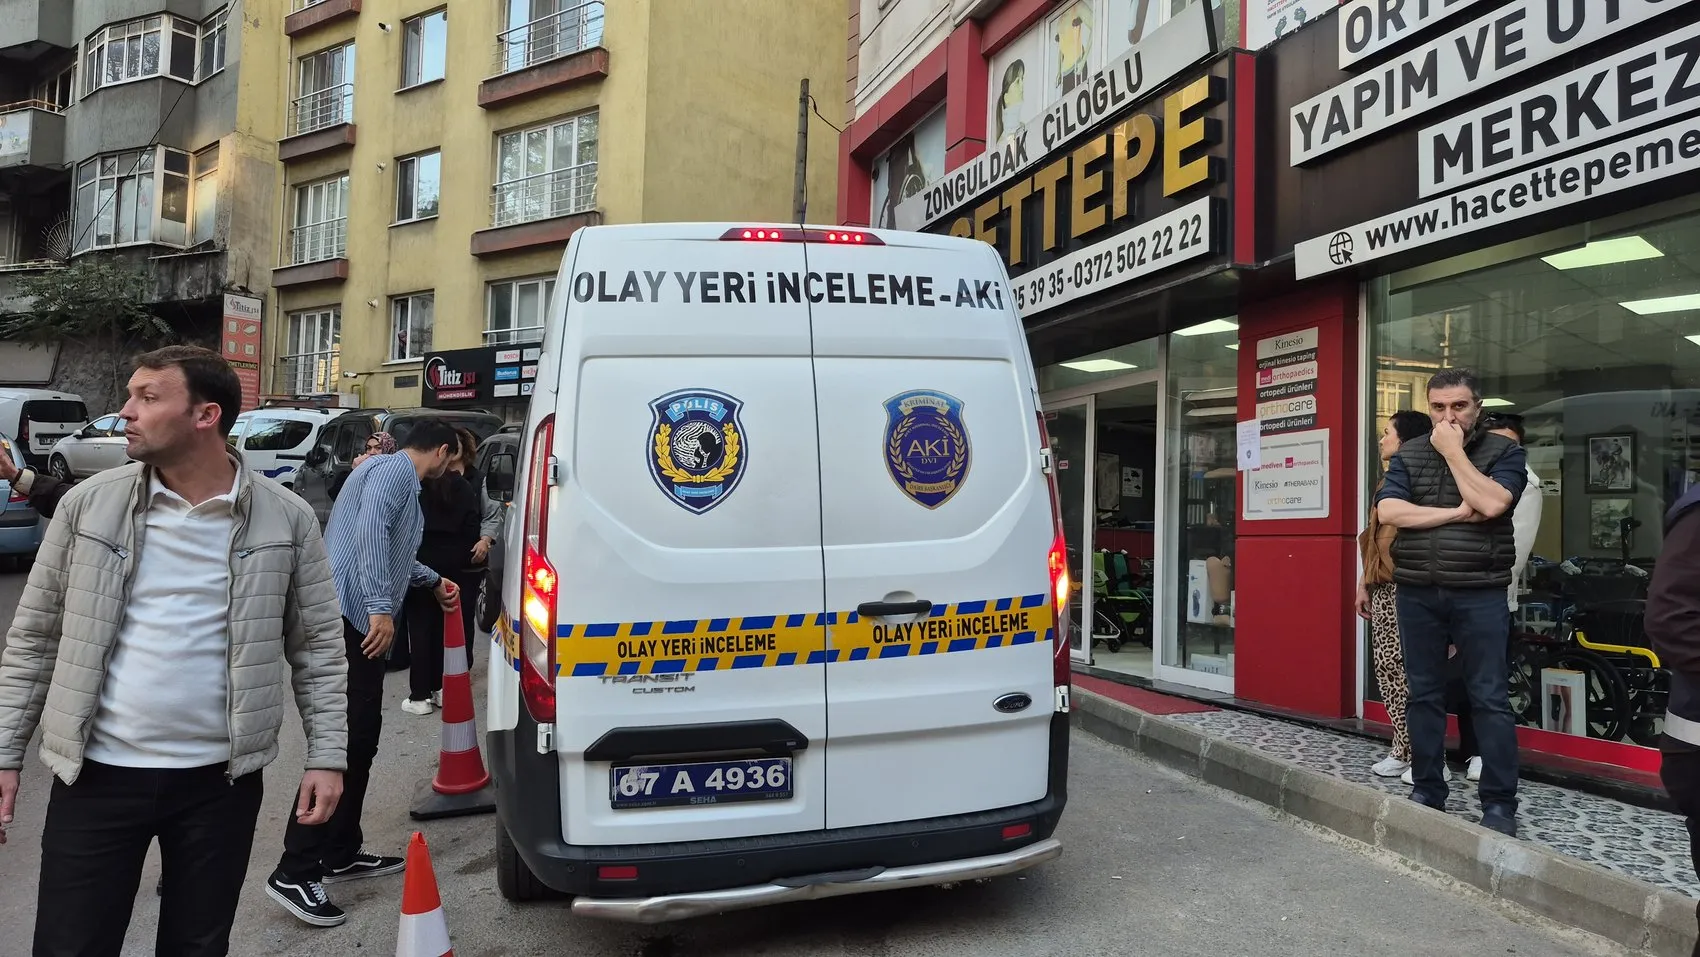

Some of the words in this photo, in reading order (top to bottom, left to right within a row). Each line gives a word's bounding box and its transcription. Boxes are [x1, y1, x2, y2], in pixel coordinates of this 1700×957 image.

[1295, 48, 1438, 152] YAPIM
[1455, 7, 1526, 82] VE
[924, 131, 1028, 221] ZONGULDAK
[1366, 129, 1700, 251] www.hacettepeme
[1030, 277, 1044, 306] 39
[1117, 236, 1146, 273] 502
[1151, 225, 1173, 261] 22
[1179, 214, 1201, 251] 22
[574, 271, 667, 304] OLAY
[1275, 335, 1304, 351] Kinesio
[1258, 359, 1276, 370] orjinal
[1276, 355, 1297, 366] kinesio
[1297, 352, 1316, 363] taping
[438, 365, 462, 386] Titiz
[1272, 368, 1315, 382] orthopaedics
[1260, 386, 1286, 399] ortopedi
[1287, 381, 1313, 393] ürünleri
[1260, 399, 1313, 417] orthocare
[1260, 419, 1286, 432] ortopedi
[1286, 416, 1313, 428] ürünleri
[907, 436, 950, 457] AKİ
[1261, 462, 1283, 470] mediven
[1254, 480, 1279, 491] Kinesio
[872, 622, 914, 644] OLAY
[617, 639, 658, 659] OLAY
[597, 672, 695, 685] TRANSIT
[632, 685, 696, 695] CUSTOM
[618, 771, 660, 797] 67
[670, 770, 696, 794] A
[704, 764, 786, 791] 4936
[689, 795, 717, 805] SEHA
